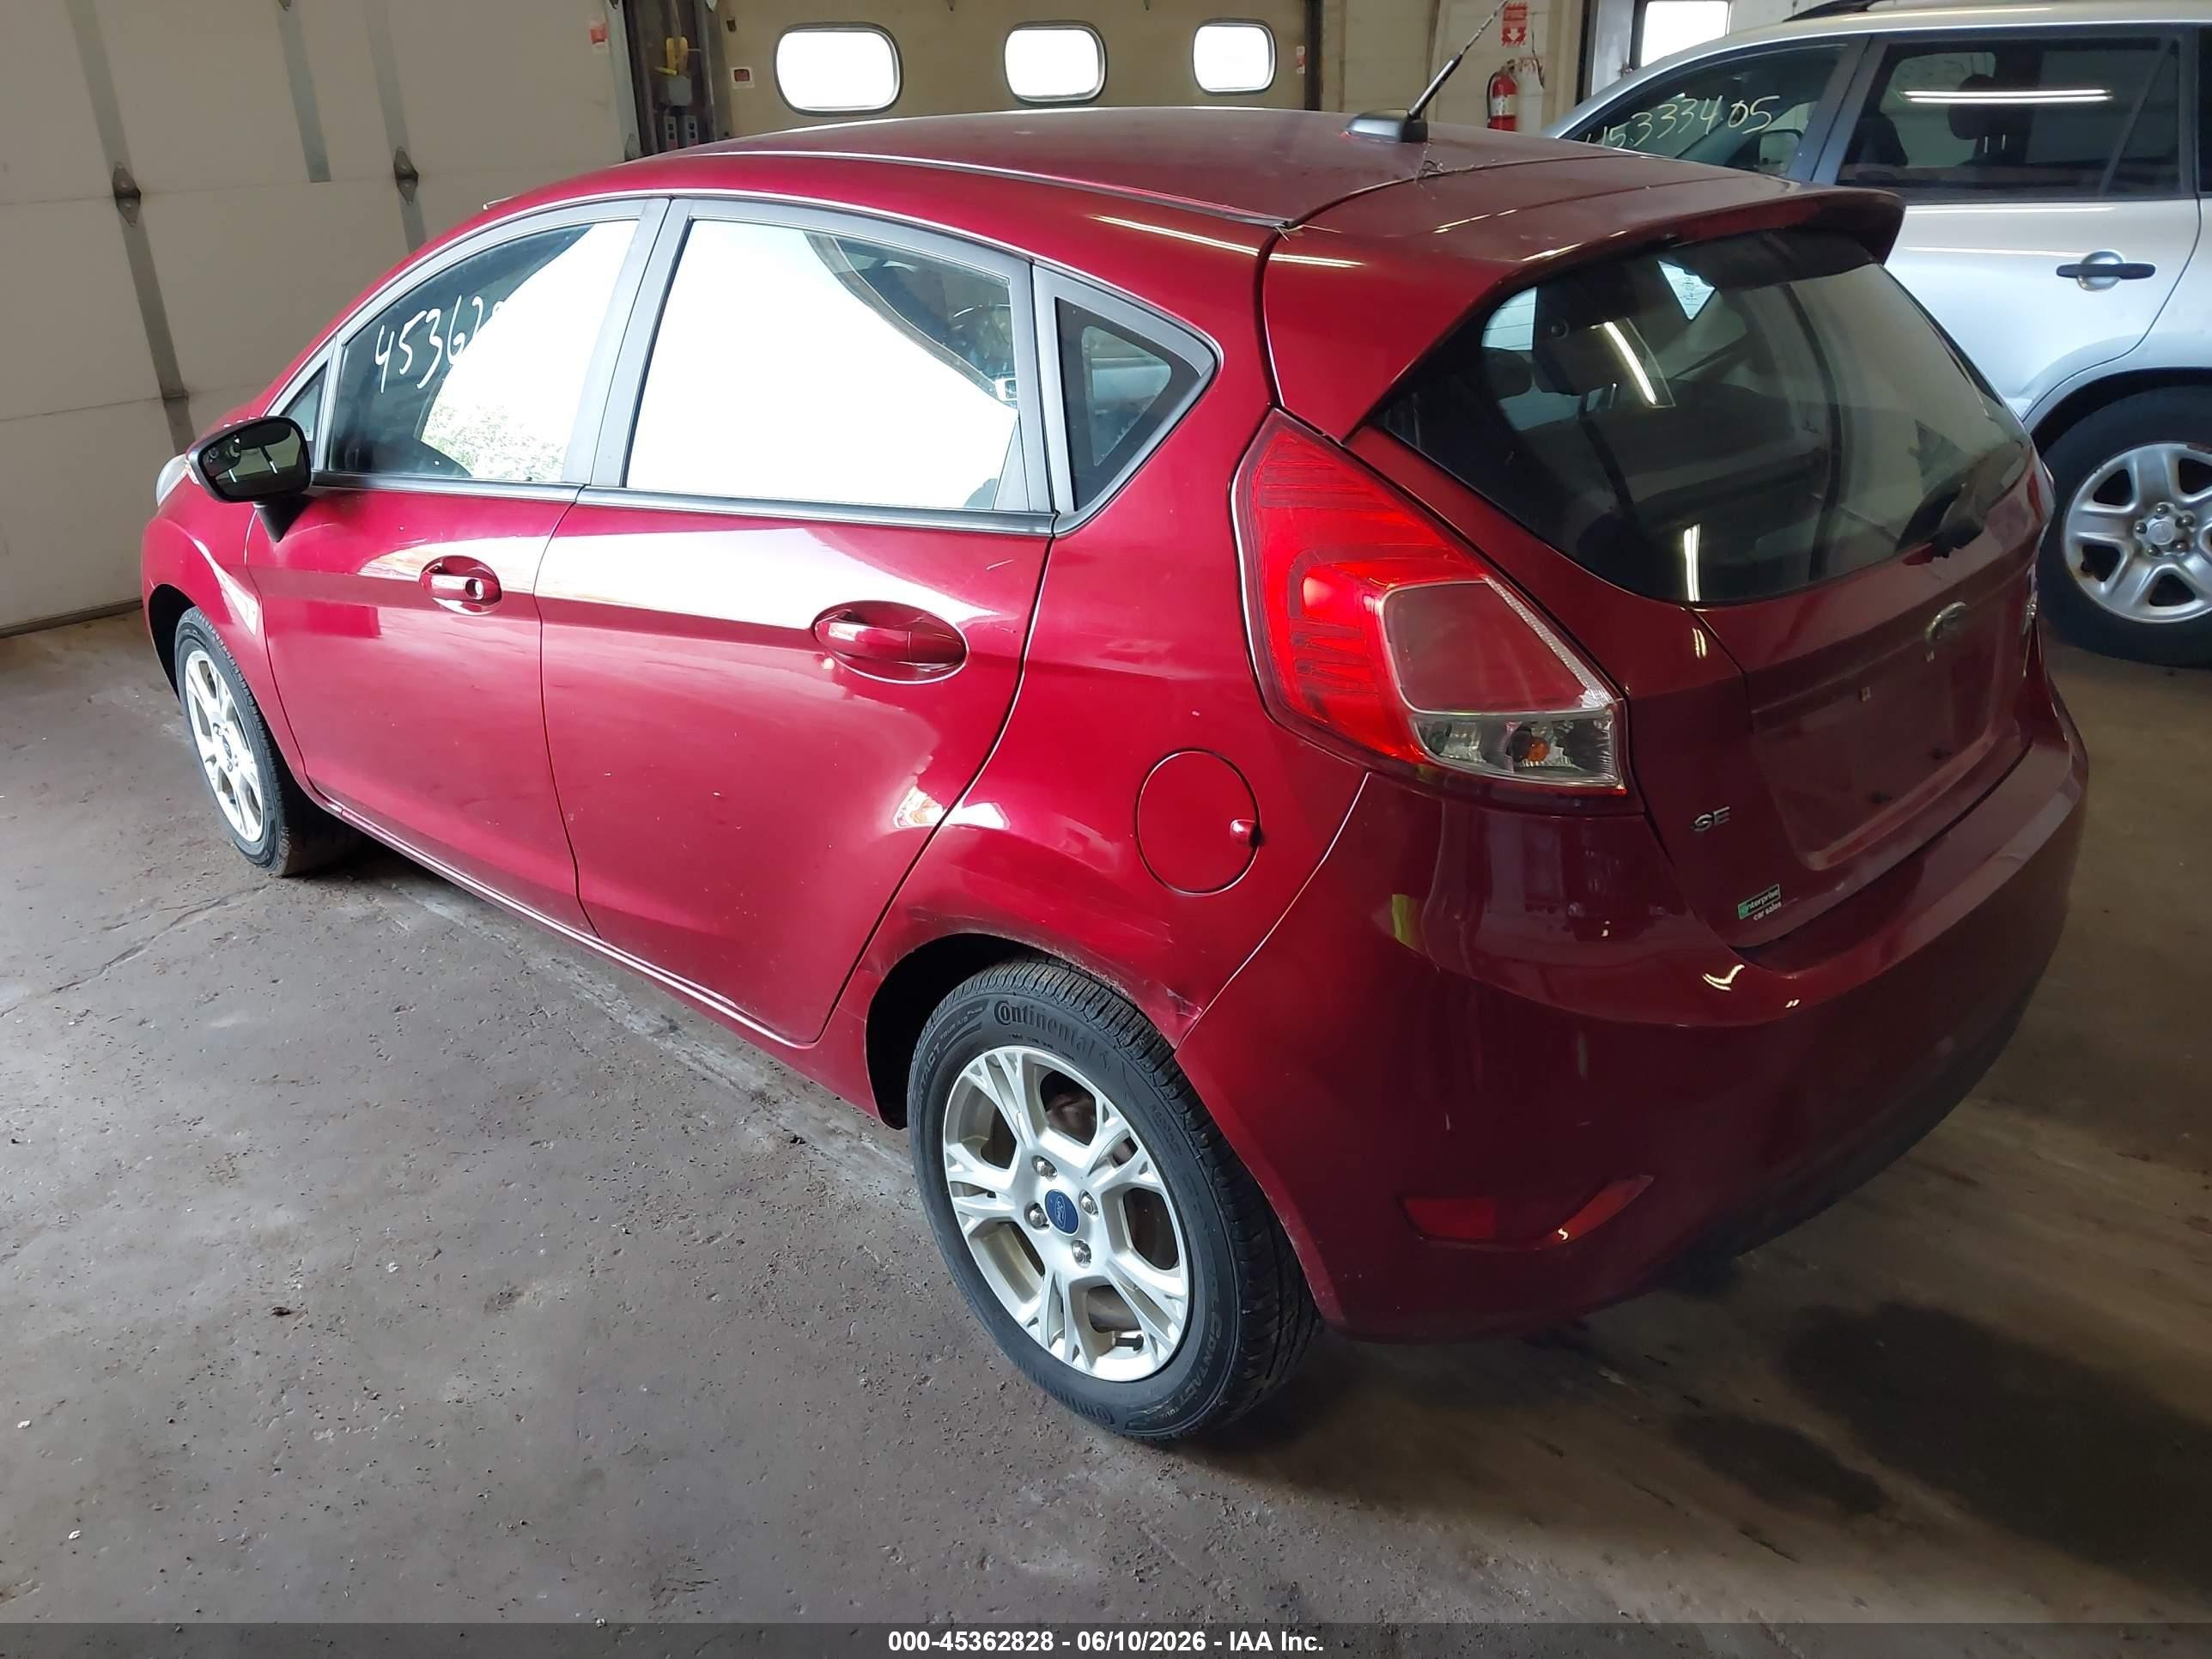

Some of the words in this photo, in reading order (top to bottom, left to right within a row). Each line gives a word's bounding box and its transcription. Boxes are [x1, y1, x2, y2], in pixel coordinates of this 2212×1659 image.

[375, 295, 504, 393] 45362
[1690, 806, 1730, 831] SE
[994, 1000, 1095, 1058] Continental
